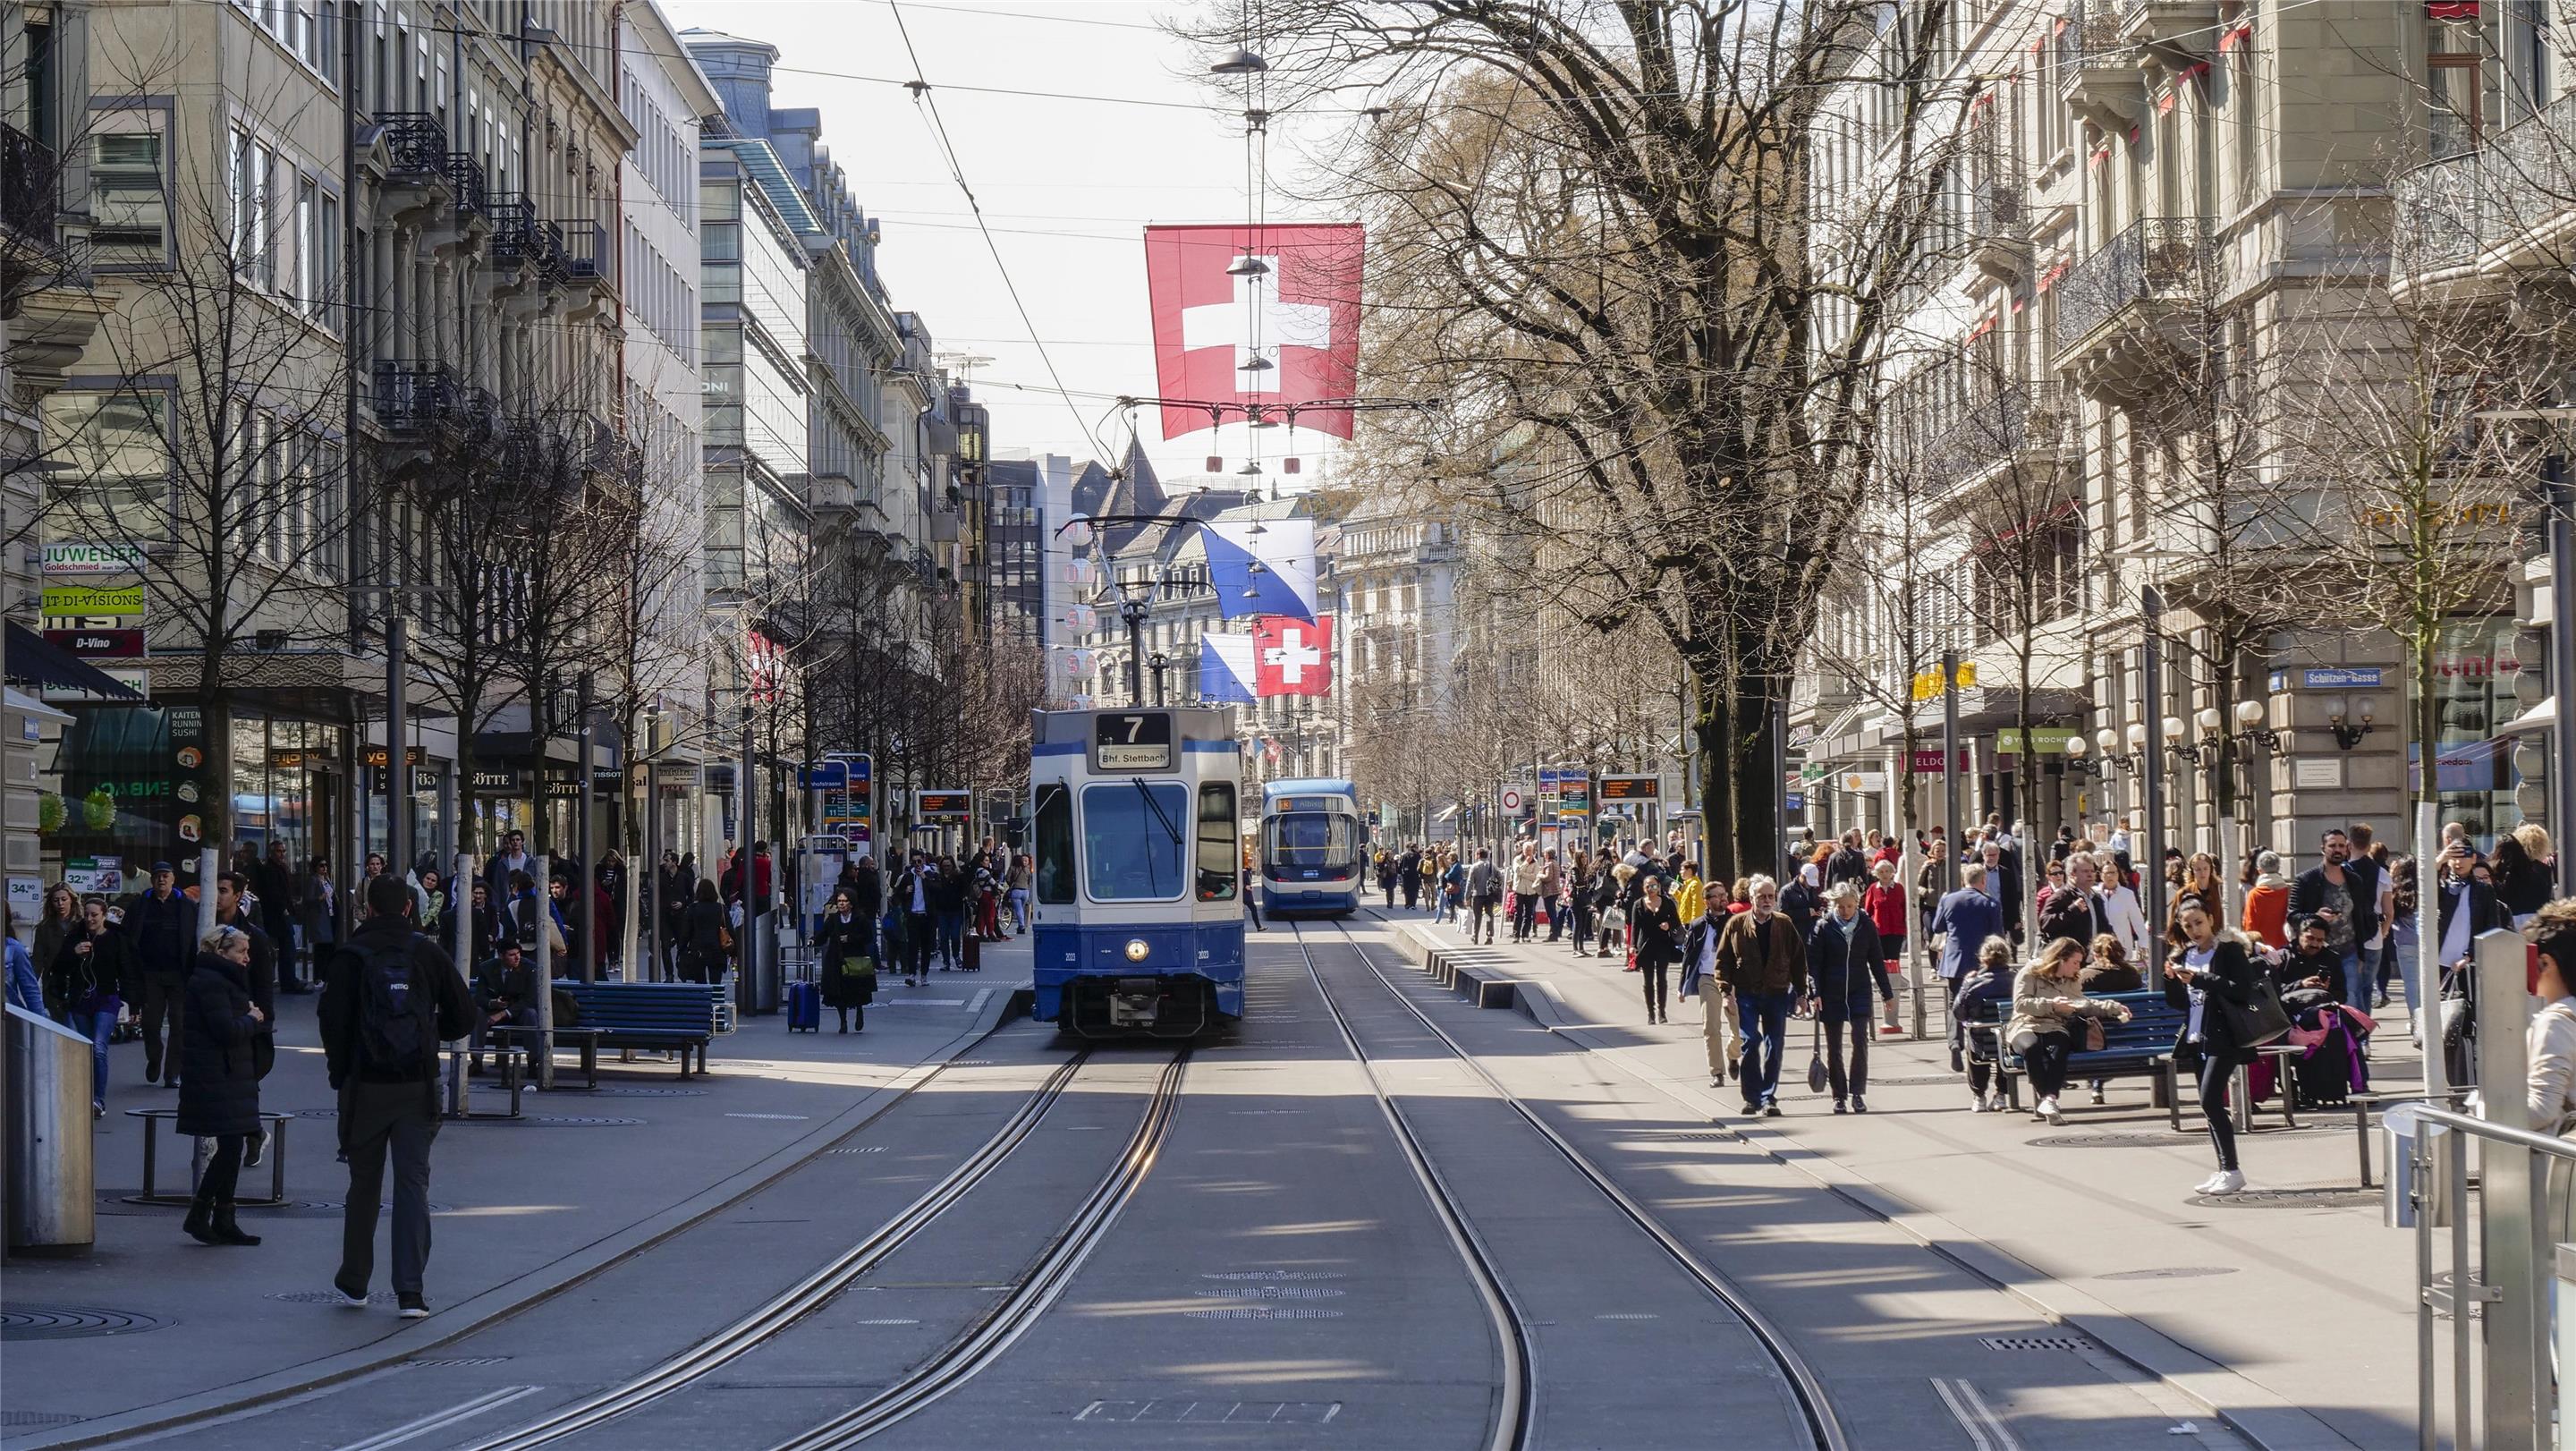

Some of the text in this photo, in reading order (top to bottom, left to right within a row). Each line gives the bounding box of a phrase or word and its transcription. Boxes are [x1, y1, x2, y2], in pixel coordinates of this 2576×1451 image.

[45, 547, 140, 563] JUWELIER
[45, 563, 99, 571] Goldschmied
[47, 595, 59, 607] IT
[76, 637, 110, 649] D-Vino
[172, 711, 201, 719] KAITEN
[172, 720, 202, 728] RUNNIN
[172, 728, 198, 737] SUSHI
[1124, 717, 1143, 743] 7
[1102, 753, 1165, 763] Bhf. Stettbach
[472, 772, 509, 785] ÖTTE
[831, 796, 836, 804] 7
[1198, 950, 1209, 960] 2023
